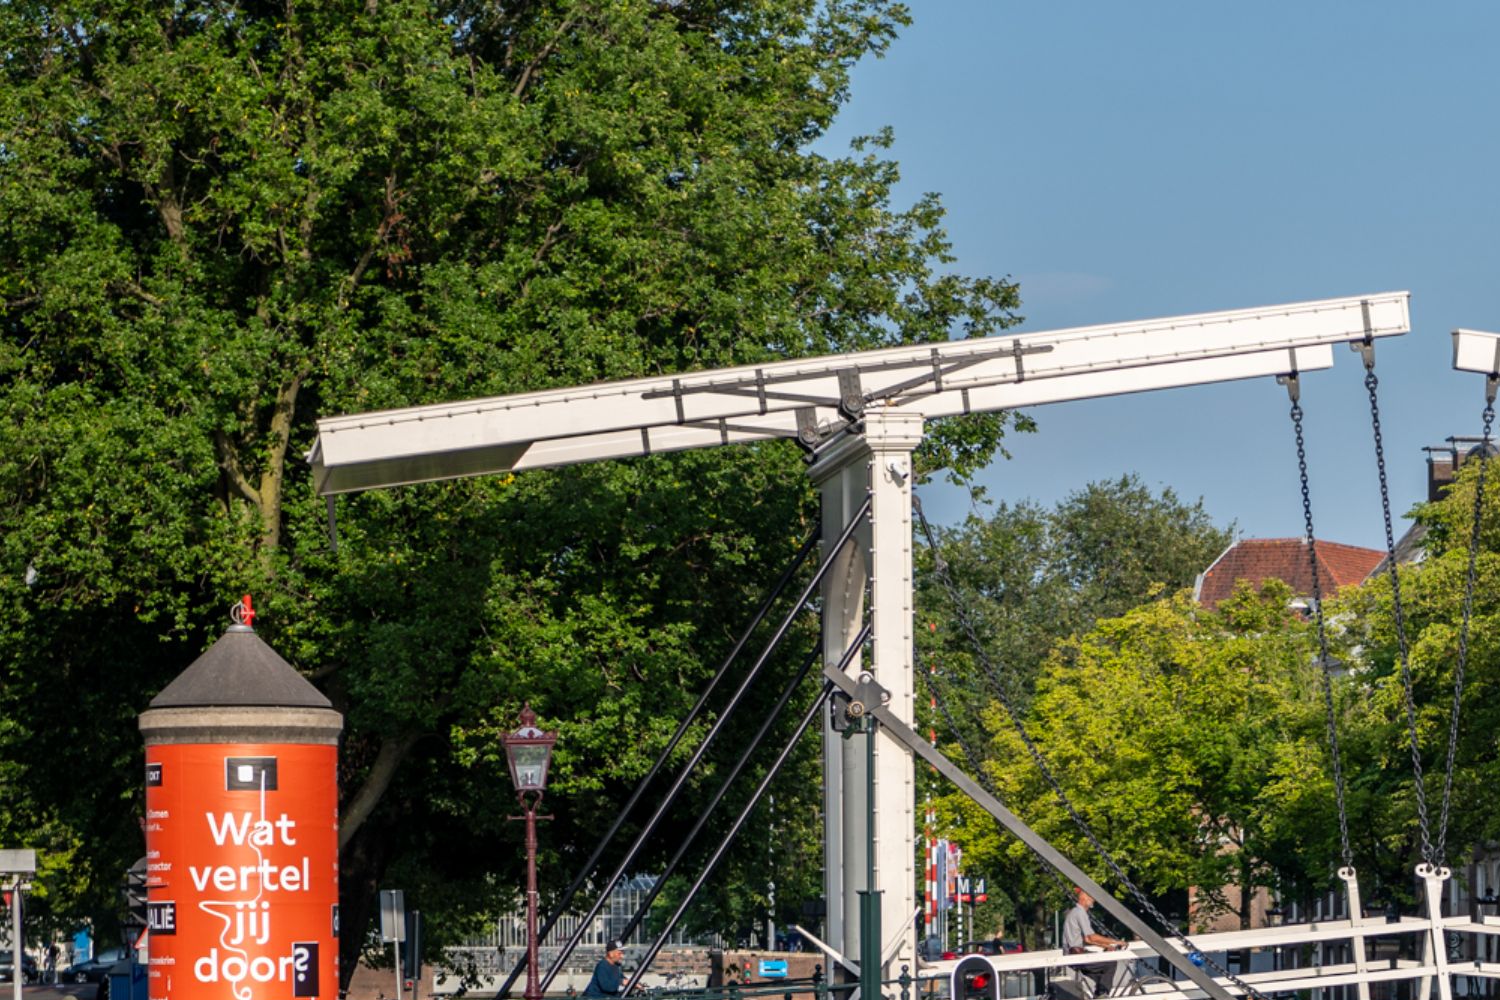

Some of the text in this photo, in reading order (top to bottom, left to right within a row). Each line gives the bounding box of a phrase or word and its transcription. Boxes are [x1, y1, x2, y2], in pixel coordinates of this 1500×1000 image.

[206, 811, 297, 846] Wat
[189, 857, 310, 892] vertel
[959, 878, 970, 893] M
[230, 901, 270, 945] jij
[194, 947, 310, 983] door?
